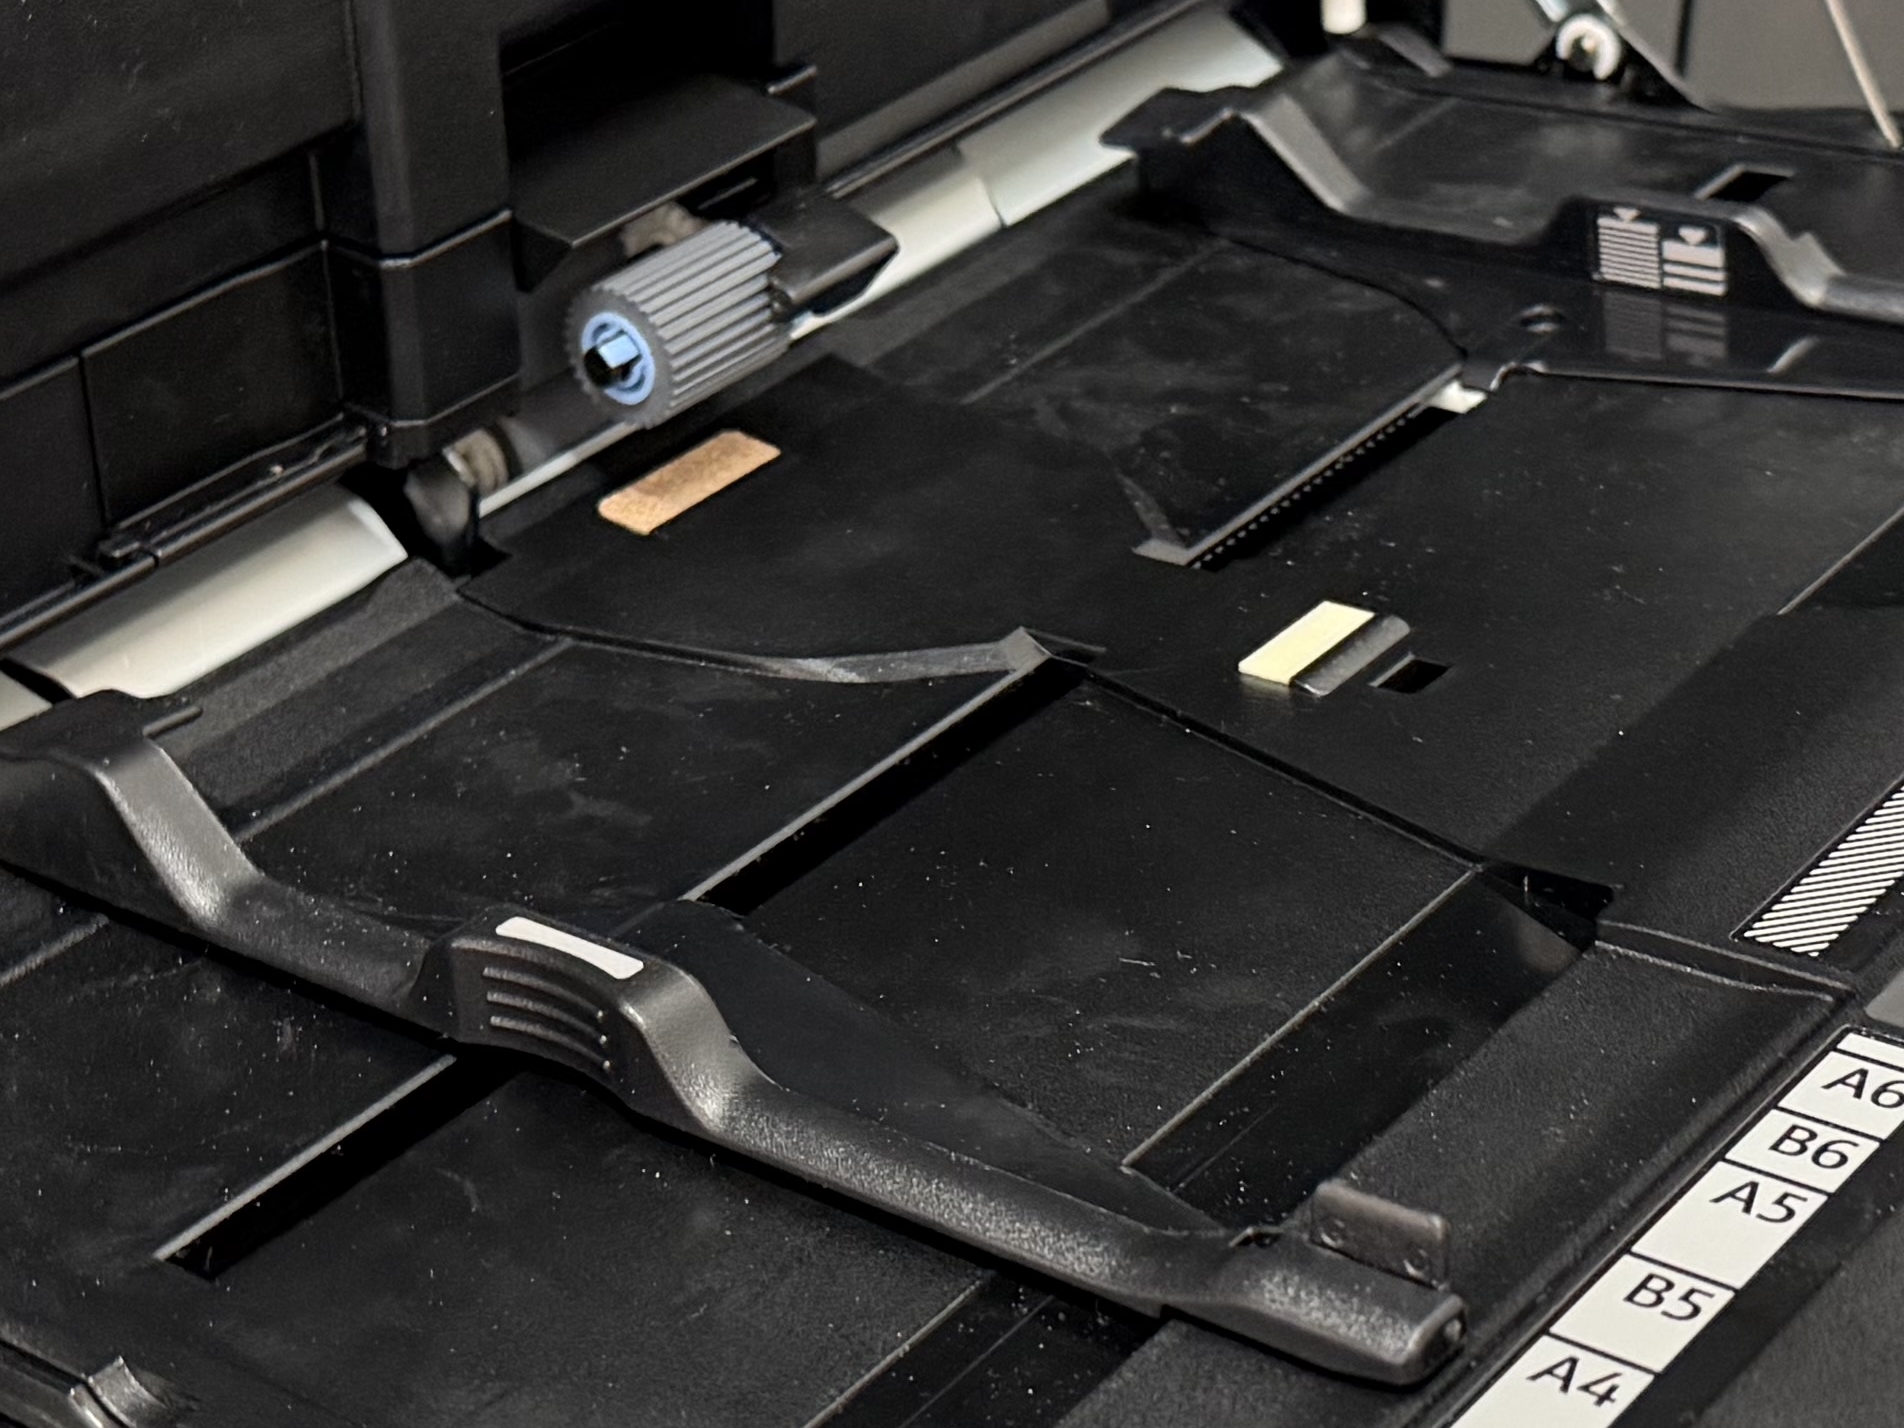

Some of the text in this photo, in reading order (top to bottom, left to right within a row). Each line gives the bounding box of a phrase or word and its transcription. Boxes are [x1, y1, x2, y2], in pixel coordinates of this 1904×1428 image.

[1768, 1124, 1859, 1169] B6
[1709, 1180, 1808, 1224] A5
[1623, 1273, 1715, 1321] B5
[1527, 1356, 1623, 1407] A4
